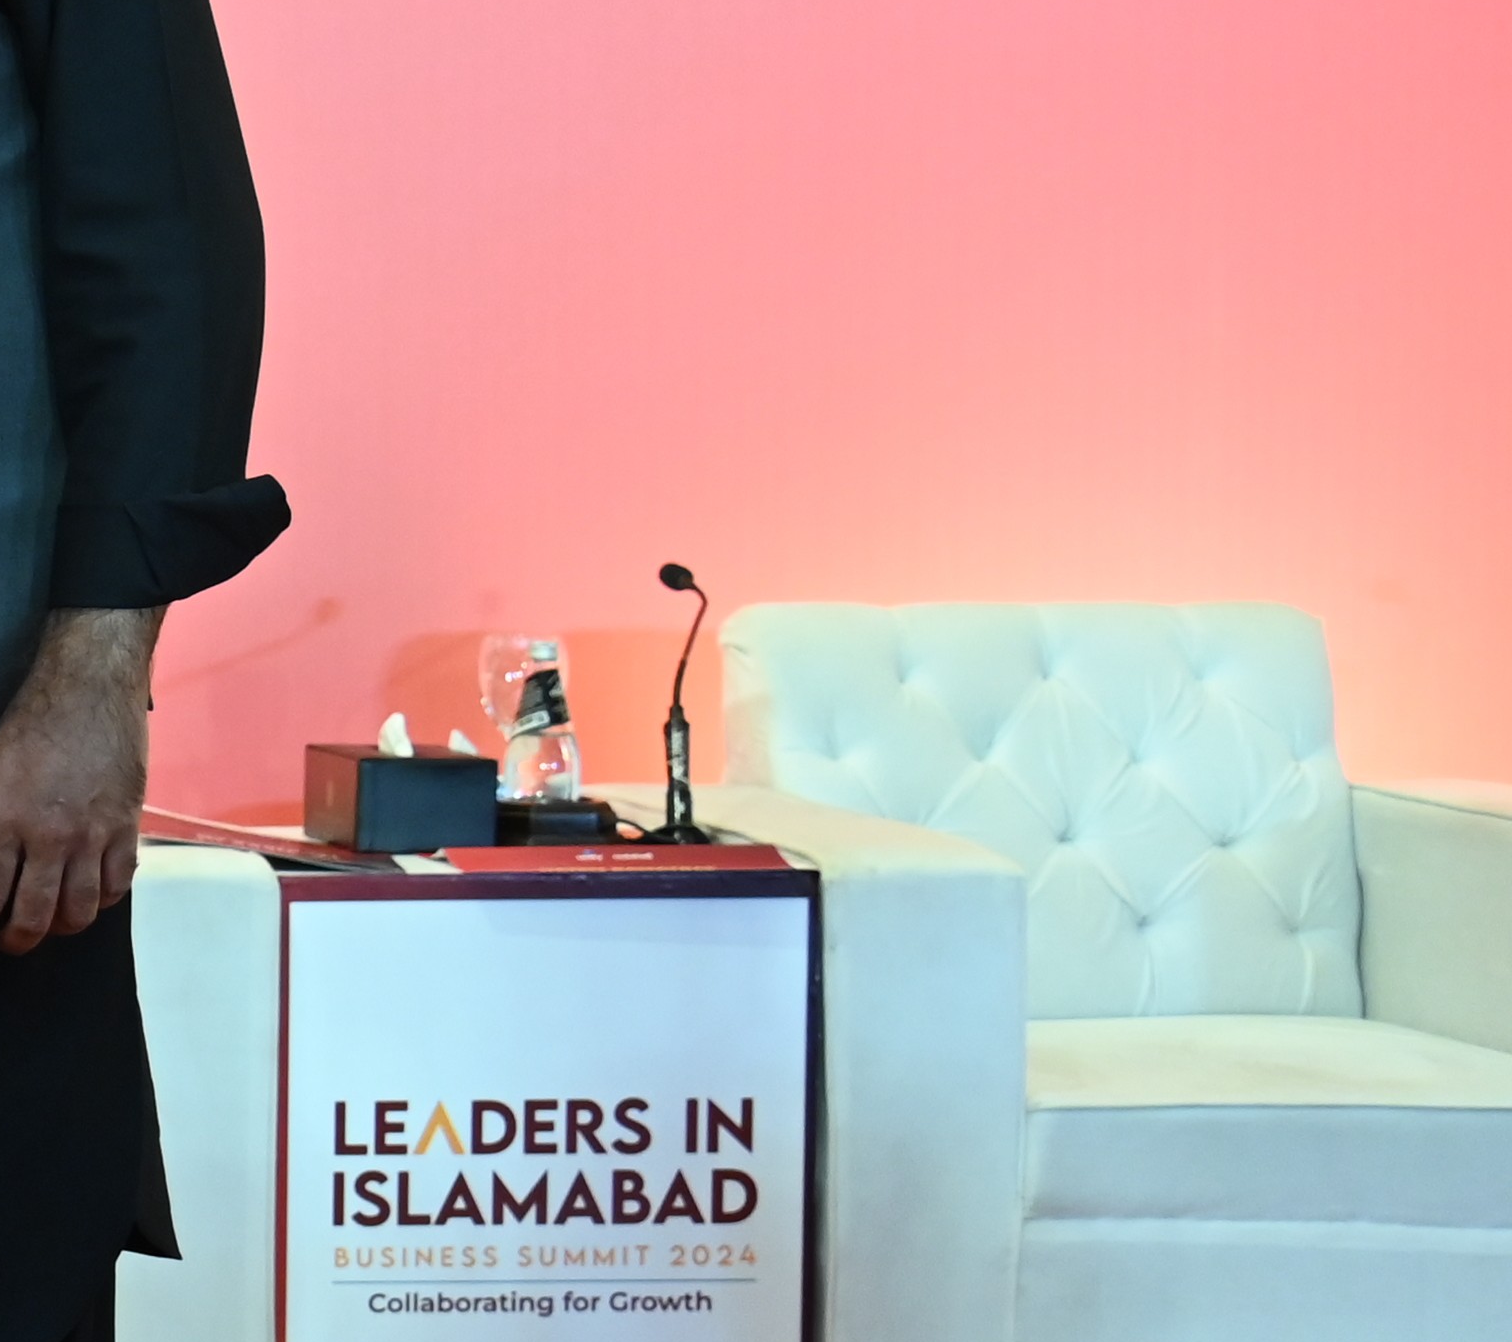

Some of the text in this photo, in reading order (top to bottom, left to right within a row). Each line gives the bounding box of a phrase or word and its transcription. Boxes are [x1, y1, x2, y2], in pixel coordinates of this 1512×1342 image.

[334, 1097, 754, 1156] LEADERS IN
[333, 1168, 759, 1227] ISLAMABAD
[334, 1243, 759, 1268] BUSINESS SUMMIT 2024
[368, 1290, 713, 1317] Collaborating for Growth
